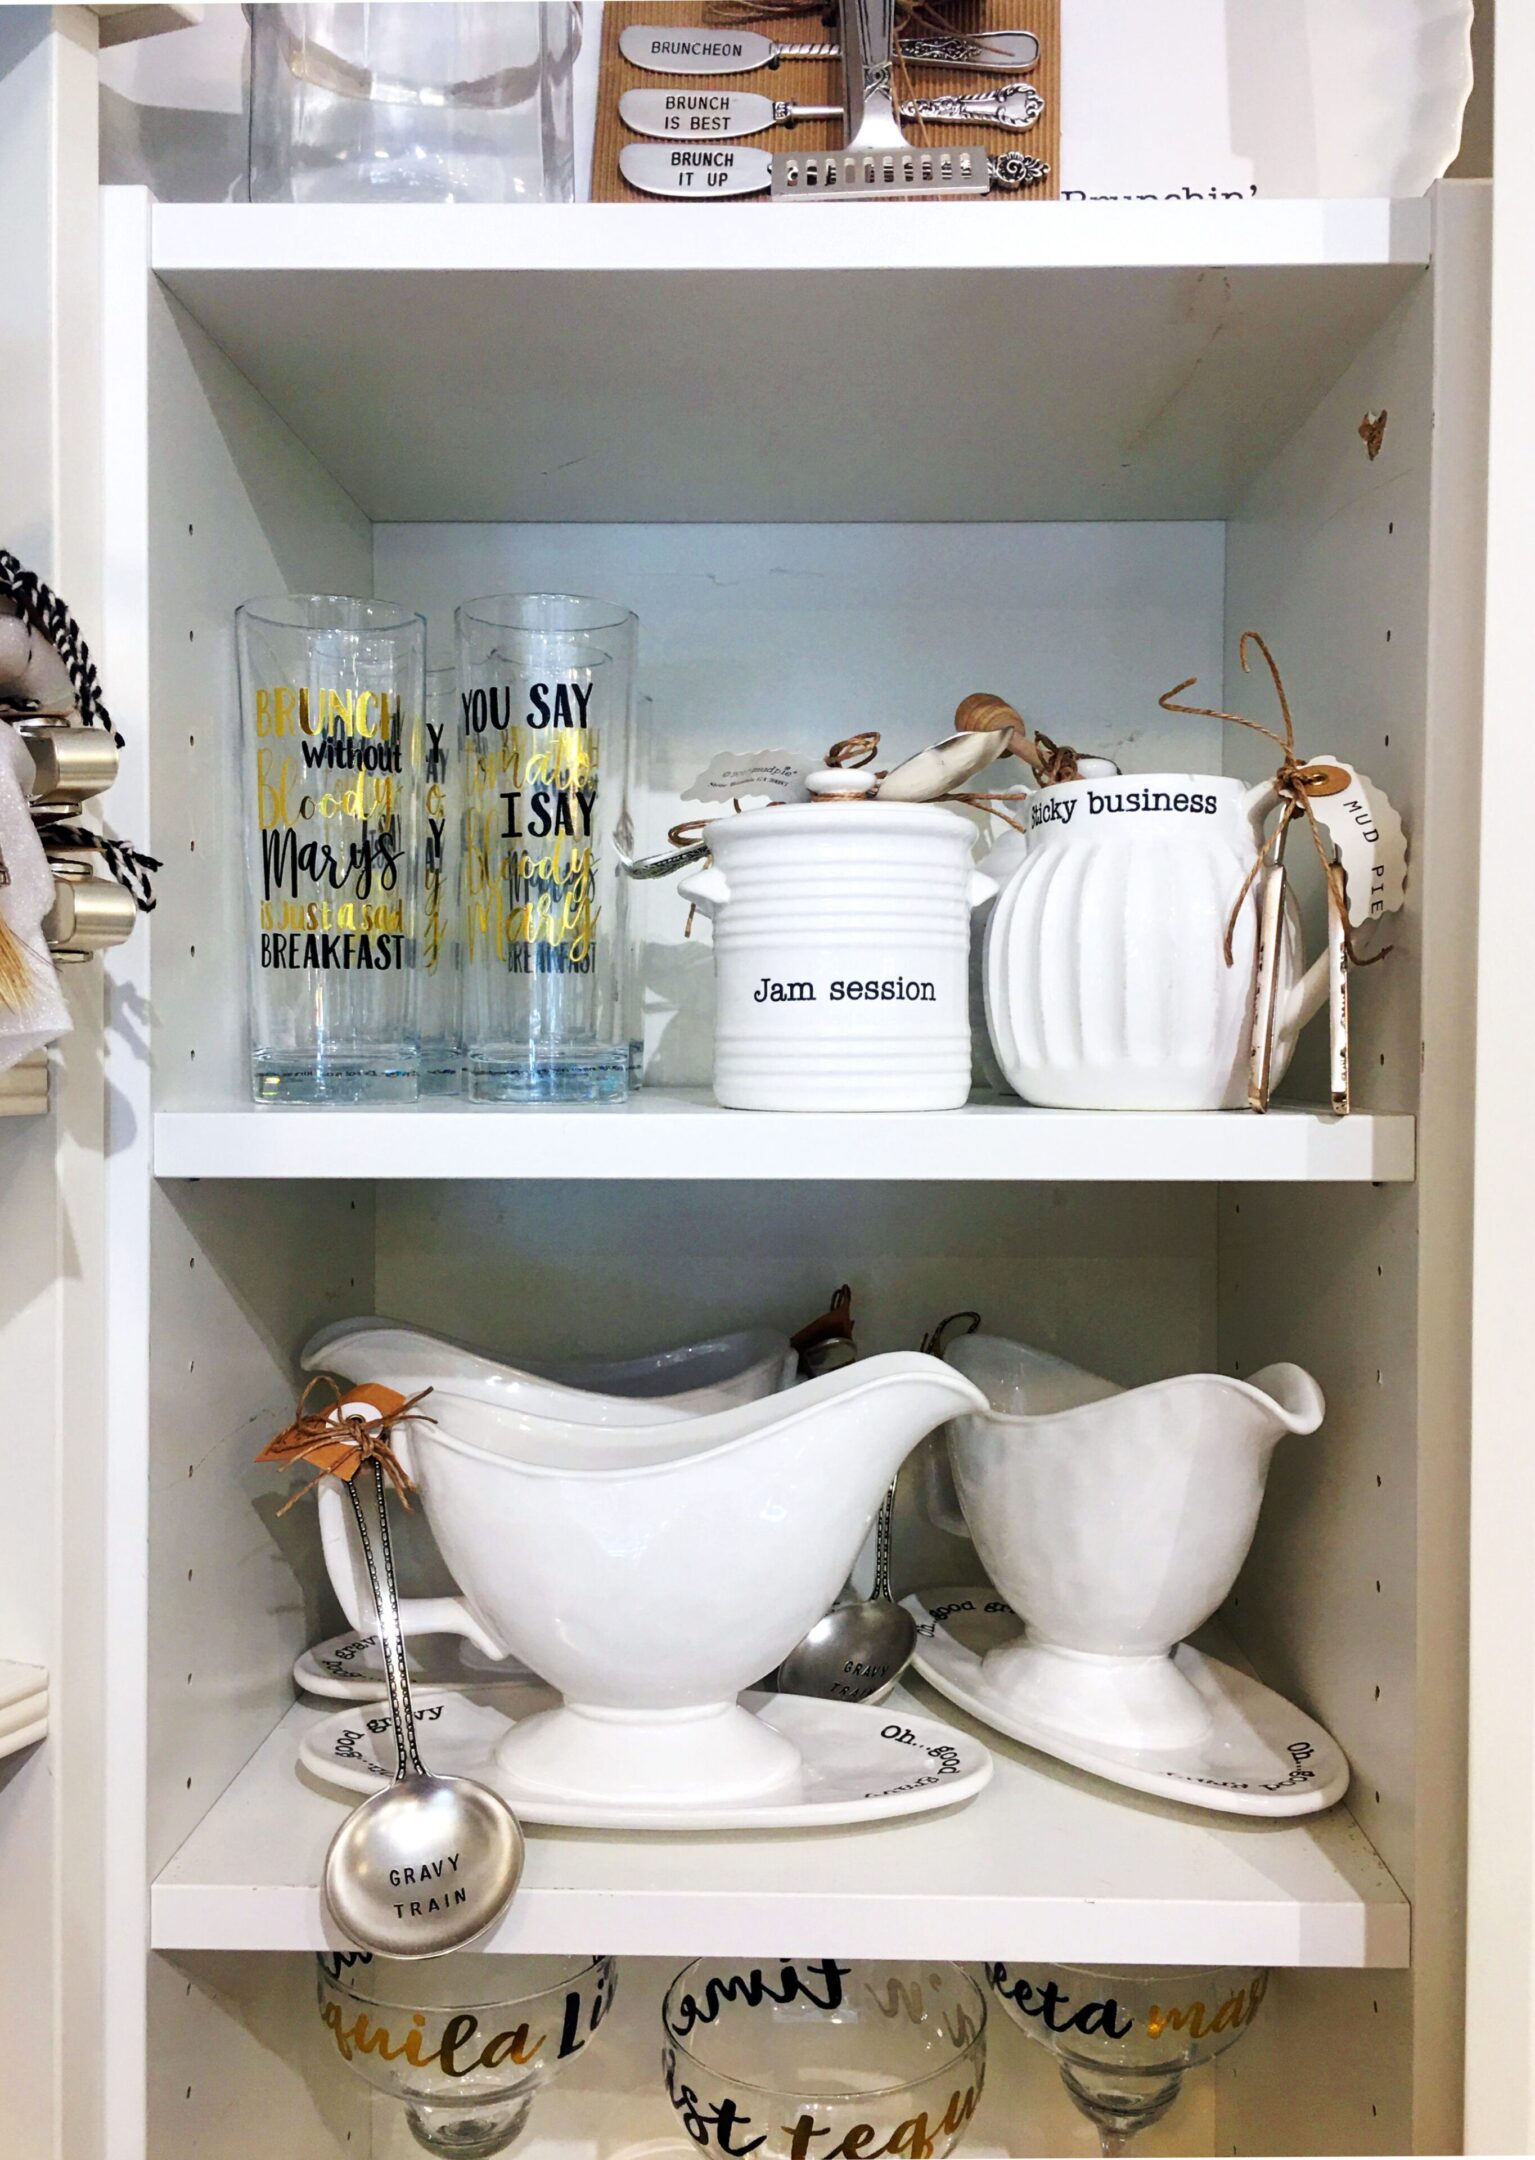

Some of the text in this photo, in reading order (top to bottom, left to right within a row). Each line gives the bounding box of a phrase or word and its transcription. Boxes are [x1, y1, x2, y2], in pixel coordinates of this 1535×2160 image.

[650, 41, 743, 57] BRUNCHEON
[665, 96, 730, 111] BRUNCH
[664, 114, 731, 131] IS BEST
[671, 152, 734, 168] BRUNCH
[678, 171, 729, 187] IT UP
[255, 687, 401, 738] BRUNCH
[461, 682, 594, 736] YOU SAY
[301, 736, 403, 773] without
[500, 791, 597, 839] I SAY
[1031, 788, 1218, 830] Sticky business
[261, 827, 406, 901] Marys
[1343, 799, 1386, 914] MUD PIE
[260, 932, 406, 970] BREAKFAST
[753, 976, 937, 1003] Jam session
[335, 1635, 379, 1660] grav
[843, 1660, 890, 1678] GRAVY
[366, 1705, 444, 1734] grvy
[389, 1853, 460, 1888] GRAVY
[393, 1887, 467, 1919] TRAIN
[321, 2000, 547, 2078] quila
[780, 2085, 975, 2159] tequ
